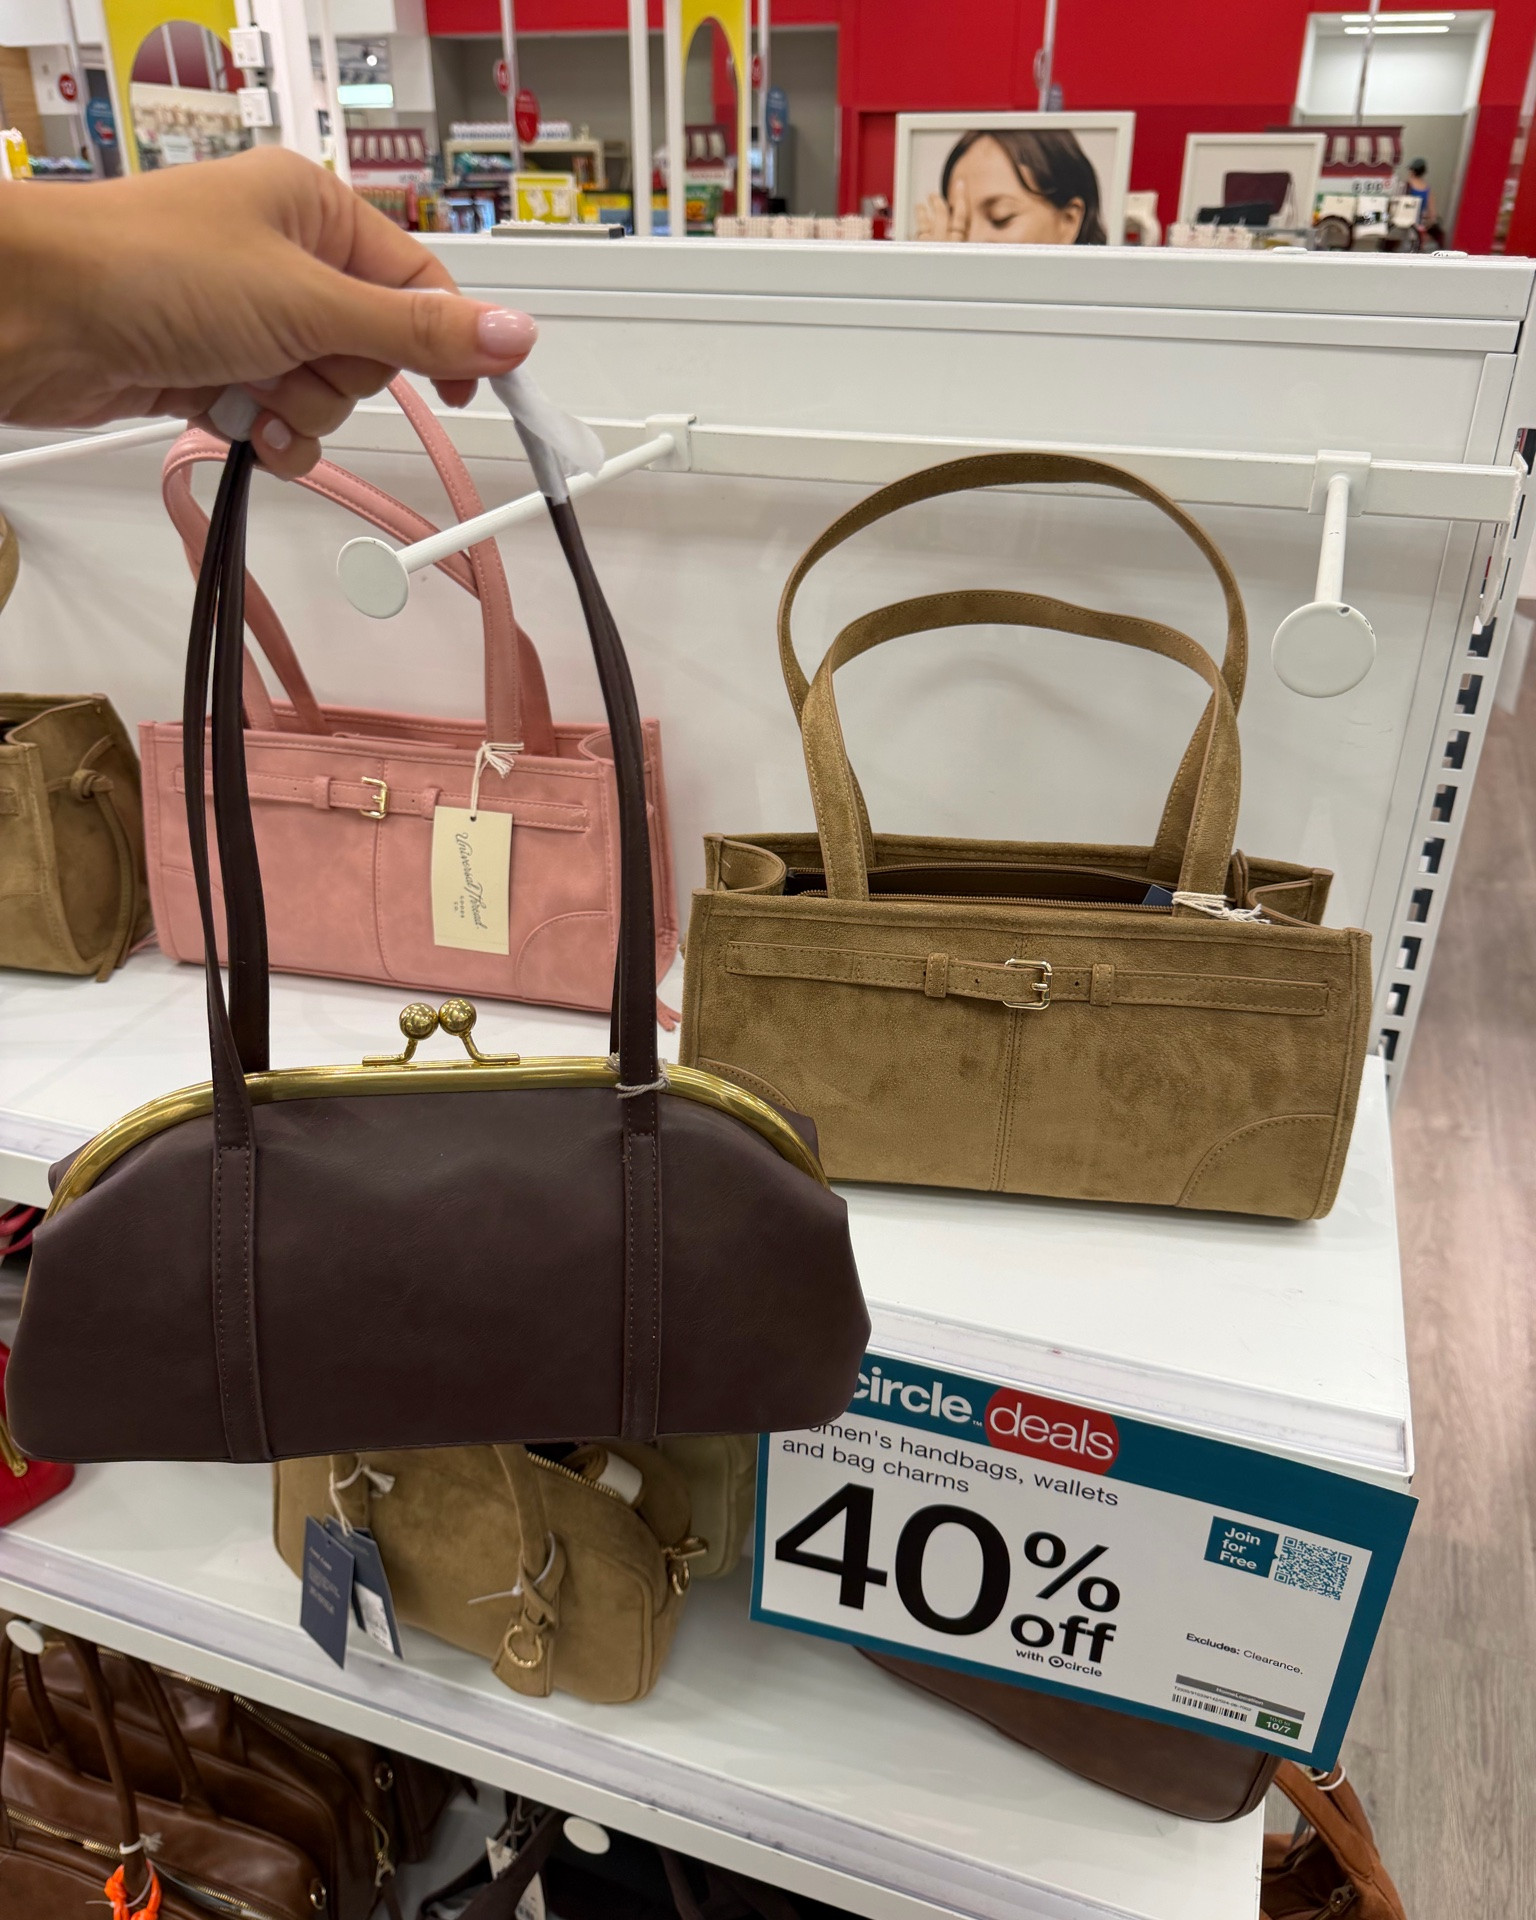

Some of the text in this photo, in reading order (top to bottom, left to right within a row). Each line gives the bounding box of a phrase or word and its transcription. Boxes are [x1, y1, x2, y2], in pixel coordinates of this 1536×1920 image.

[455, 832, 488, 929] Universal Thread
[989, 1402, 1114, 1460] deals
[782, 1439, 969, 1492] and bag charms
[808, 1423, 1118, 1506] men's handbags, wallets
[1222, 1538, 1247, 1553] for
[1224, 1527, 1261, 1546] Join
[1219, 1550, 1257, 1570] Free
[1010, 1613, 1117, 1663] off
[1186, 1632, 1303, 1675] Excludes: Clearance.
[1016, 1649, 1102, 1677] with circle
[1266, 1721, 1291, 1734] 10/7
